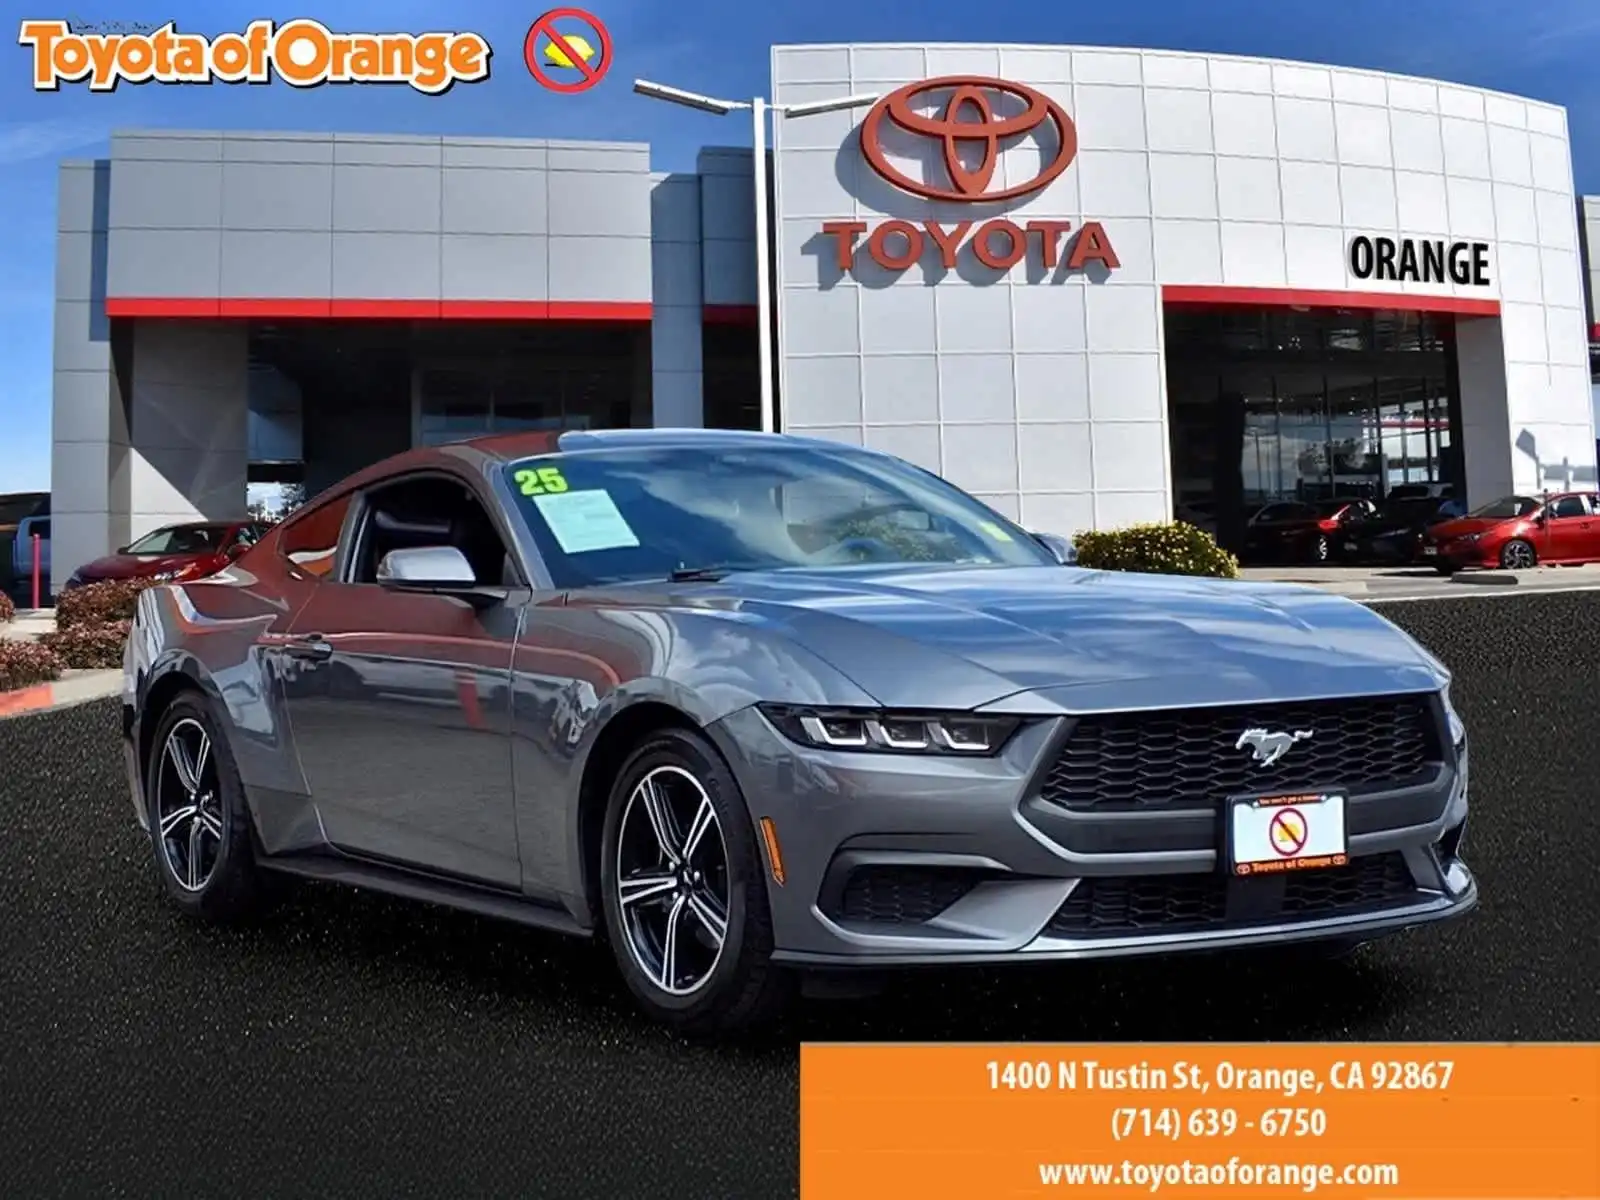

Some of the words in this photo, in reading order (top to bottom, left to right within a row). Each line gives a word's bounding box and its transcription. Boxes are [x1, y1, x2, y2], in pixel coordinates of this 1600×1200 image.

[825, 220, 1120, 269] TOYOTA
[1351, 235, 1490, 286] ORANGE
[514, 467, 568, 496] 25
